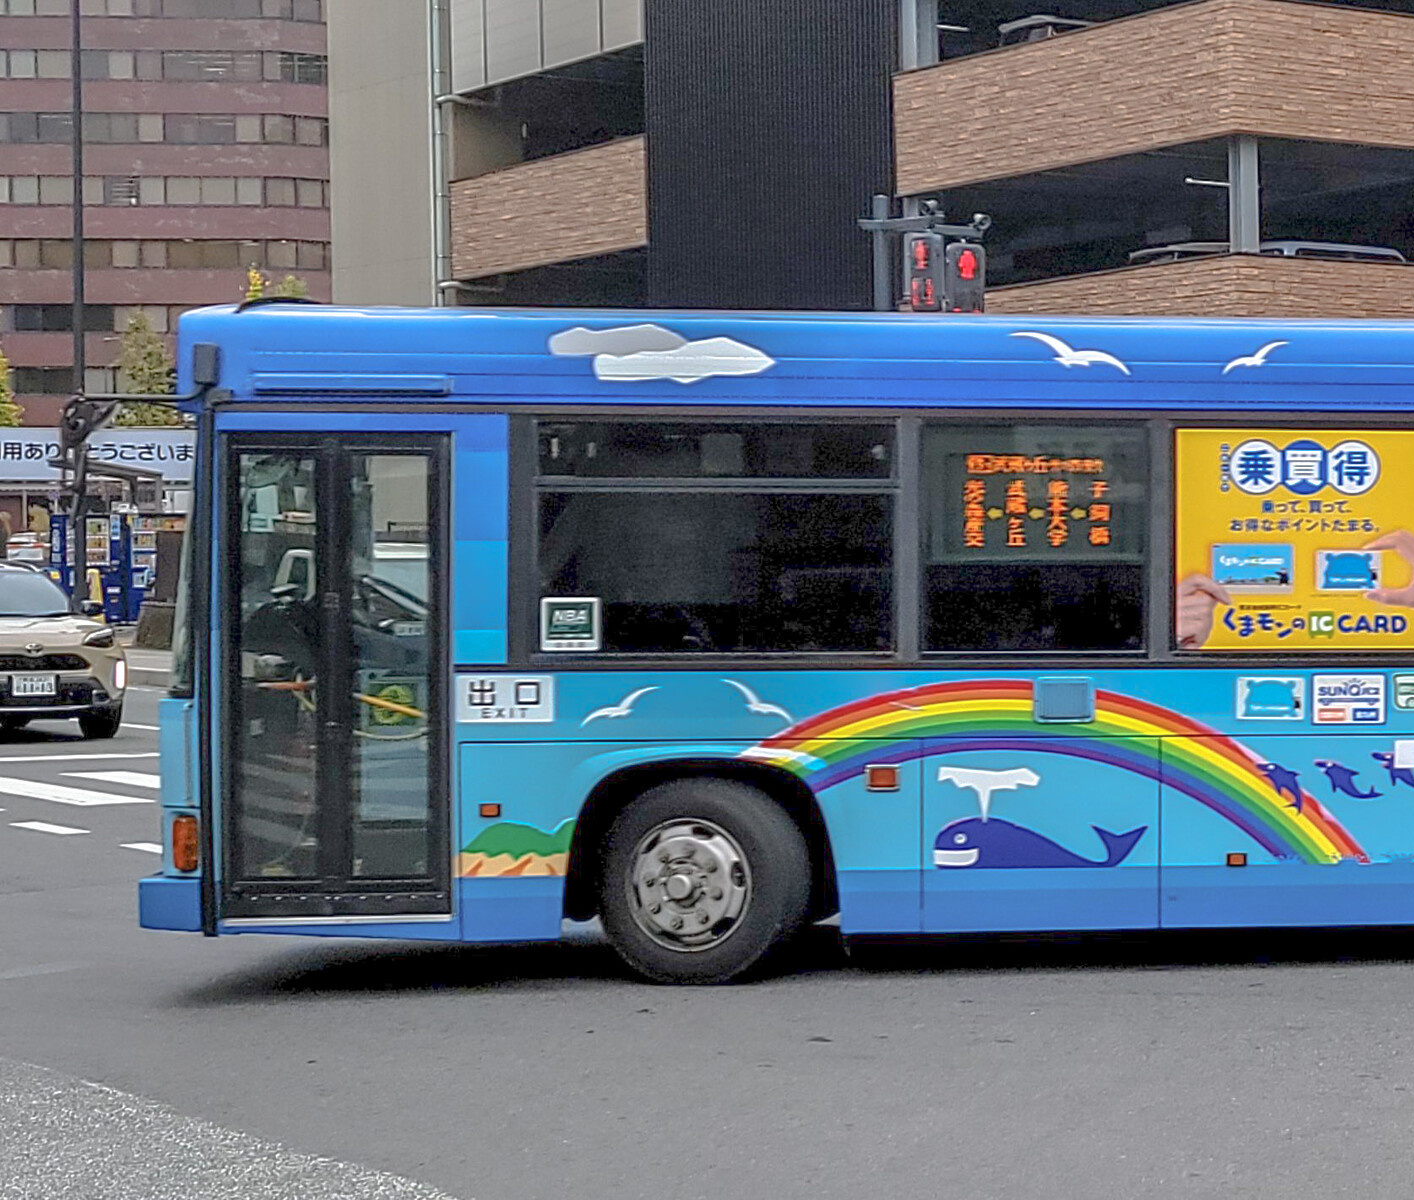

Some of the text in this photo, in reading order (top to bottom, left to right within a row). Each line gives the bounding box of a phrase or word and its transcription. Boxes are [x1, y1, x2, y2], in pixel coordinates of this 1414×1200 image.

[0, 443, 194, 461] 用ありとうございま
[1237, 448, 1372, 486] 乗買得
[1310, 615, 1334, 632] IC
[1337, 614, 1408, 634] CARD
[468, 680, 541, 706] 出口
[480, 707, 530, 719] EXIT
